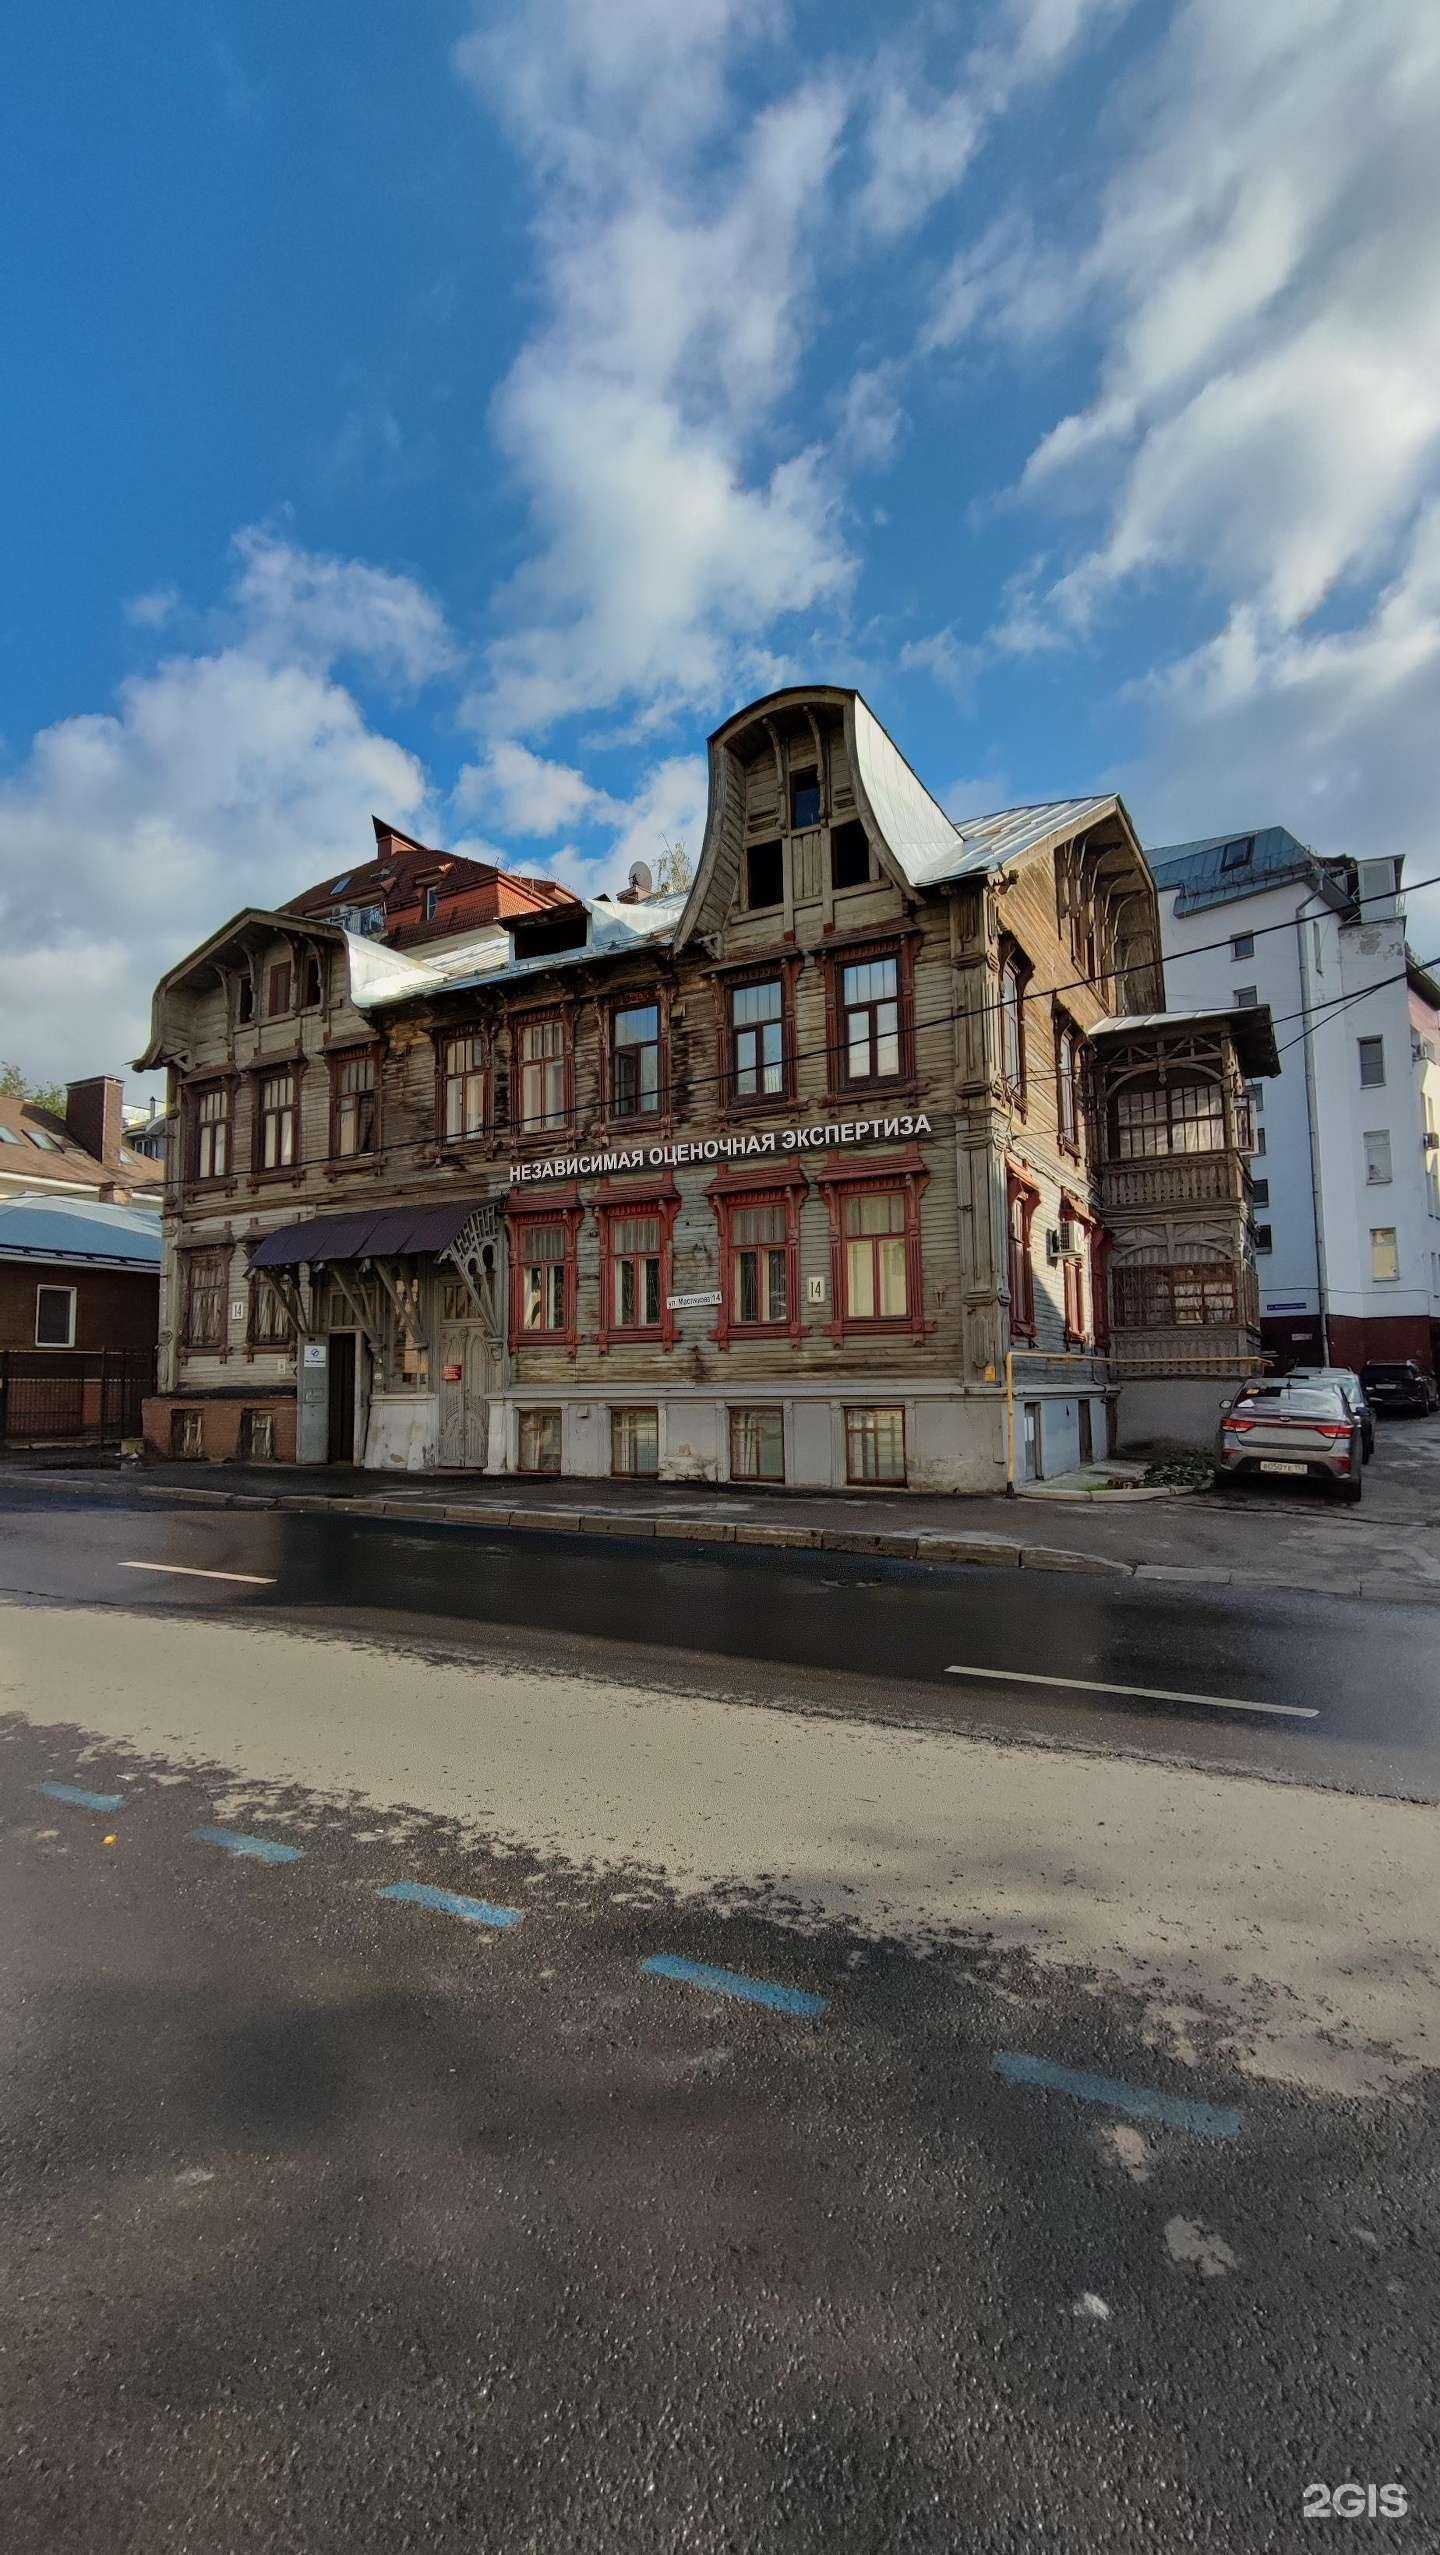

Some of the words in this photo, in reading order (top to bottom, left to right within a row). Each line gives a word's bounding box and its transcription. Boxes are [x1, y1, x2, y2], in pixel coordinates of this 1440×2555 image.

[510, 1150, 644, 1182] НЕЗАВИСИМАЯ
[649, 1133, 775, 1166] ОЦЕНОЧНАЯ
[782, 1114, 931, 1149] ЭКСПЕРТИЗА
[811, 1281, 821, 1298] 14
[234, 1303, 242, 1318] 14
